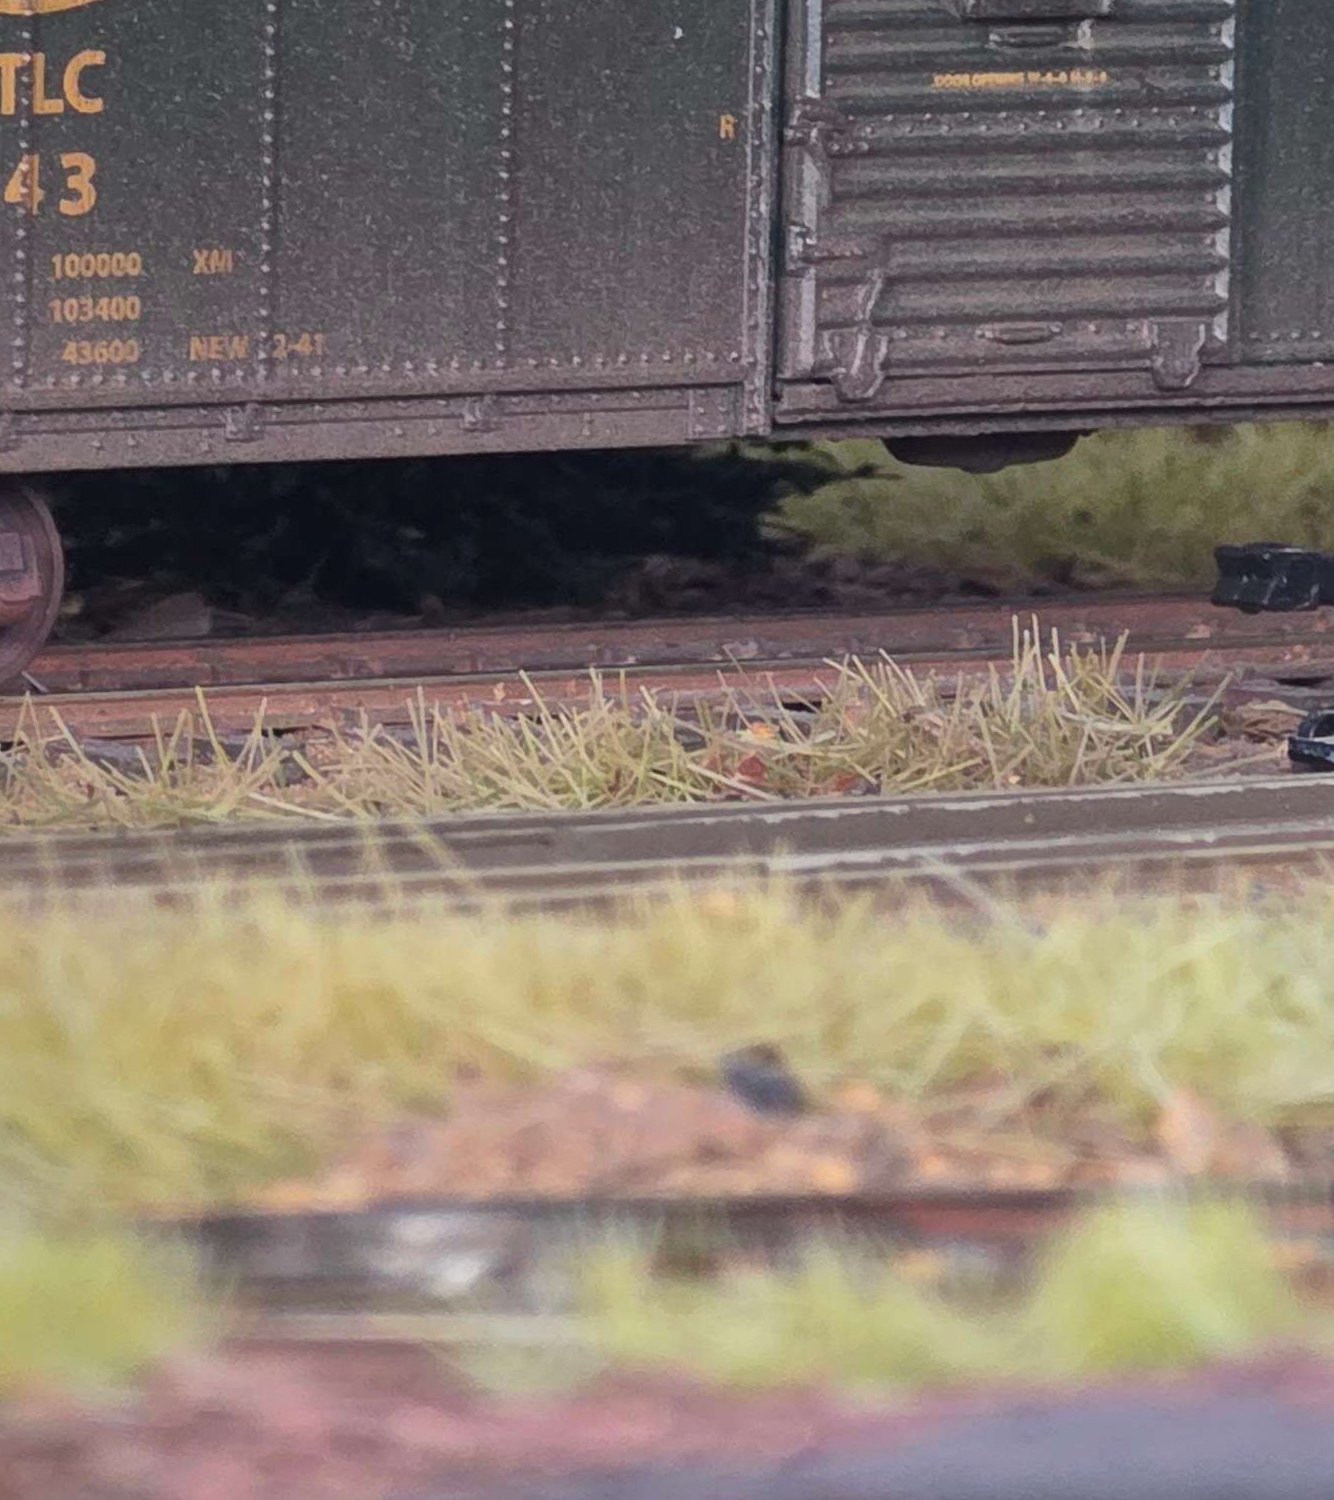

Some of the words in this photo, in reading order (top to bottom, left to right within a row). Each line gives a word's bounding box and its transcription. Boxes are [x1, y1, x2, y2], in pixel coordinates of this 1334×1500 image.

[719, 115, 735, 138] R
[51, 252, 143, 280] 100000
[49, 295, 141, 324] 103400
